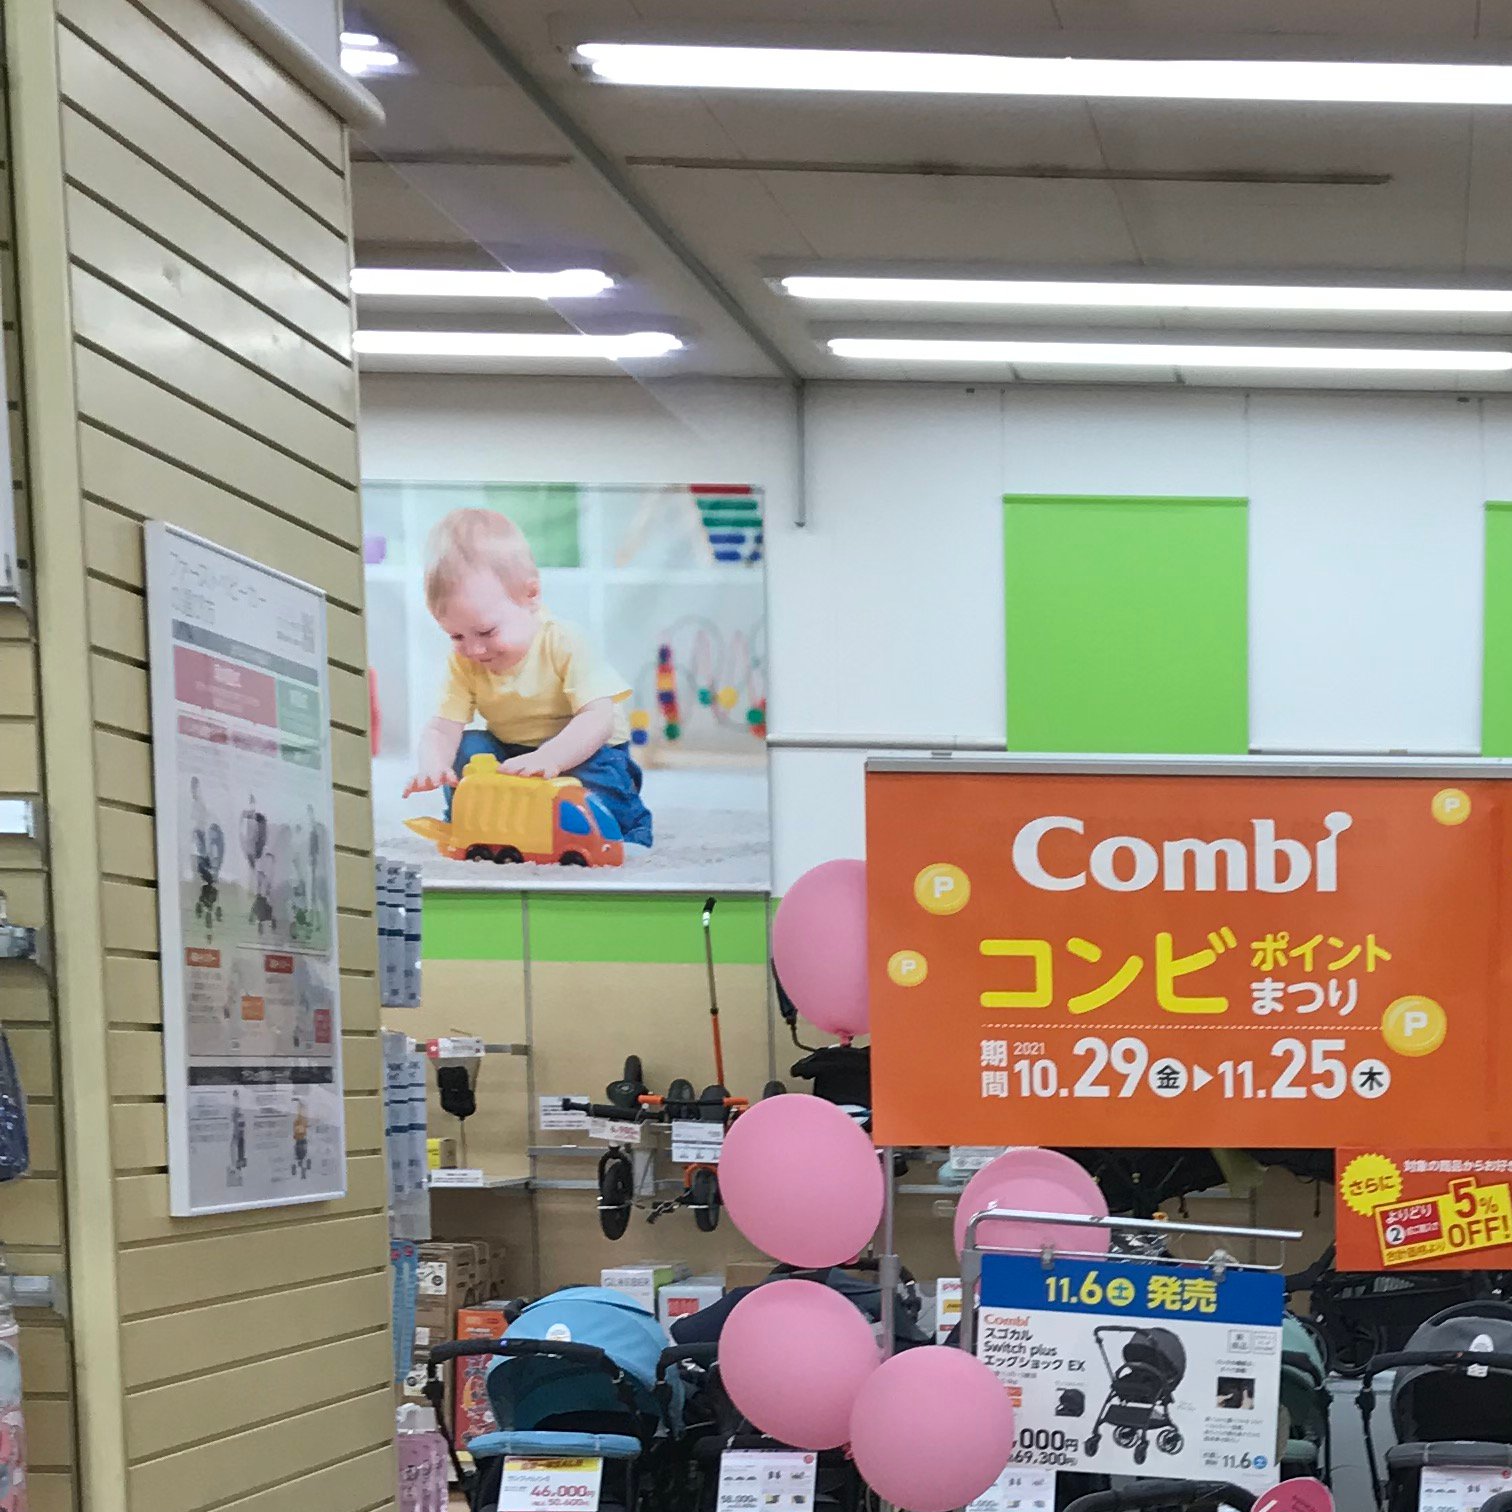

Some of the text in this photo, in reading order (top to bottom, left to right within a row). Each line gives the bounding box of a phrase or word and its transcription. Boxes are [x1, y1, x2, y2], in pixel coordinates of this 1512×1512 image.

[1011, 811, 1353, 892] Combi
[1250, 931, 1391, 973] ポイント
[979, 926, 1237, 1015] コンビ
[1250, 978, 1359, 1016] まつり
[1013, 1042, 1046, 1056] 2021
[1349, 1175, 1394, 1196] さらに
[1385, 1204, 1433, 1223] よりどり
[1146, 1275, 1218, 1314] 発売
[984, 1313, 1030, 1327] Combi
[984, 1328, 1033, 1341] スゴカル
[983, 1340, 1058, 1357] Switch plus
[1011, 1428, 1079, 1452] ,000円
